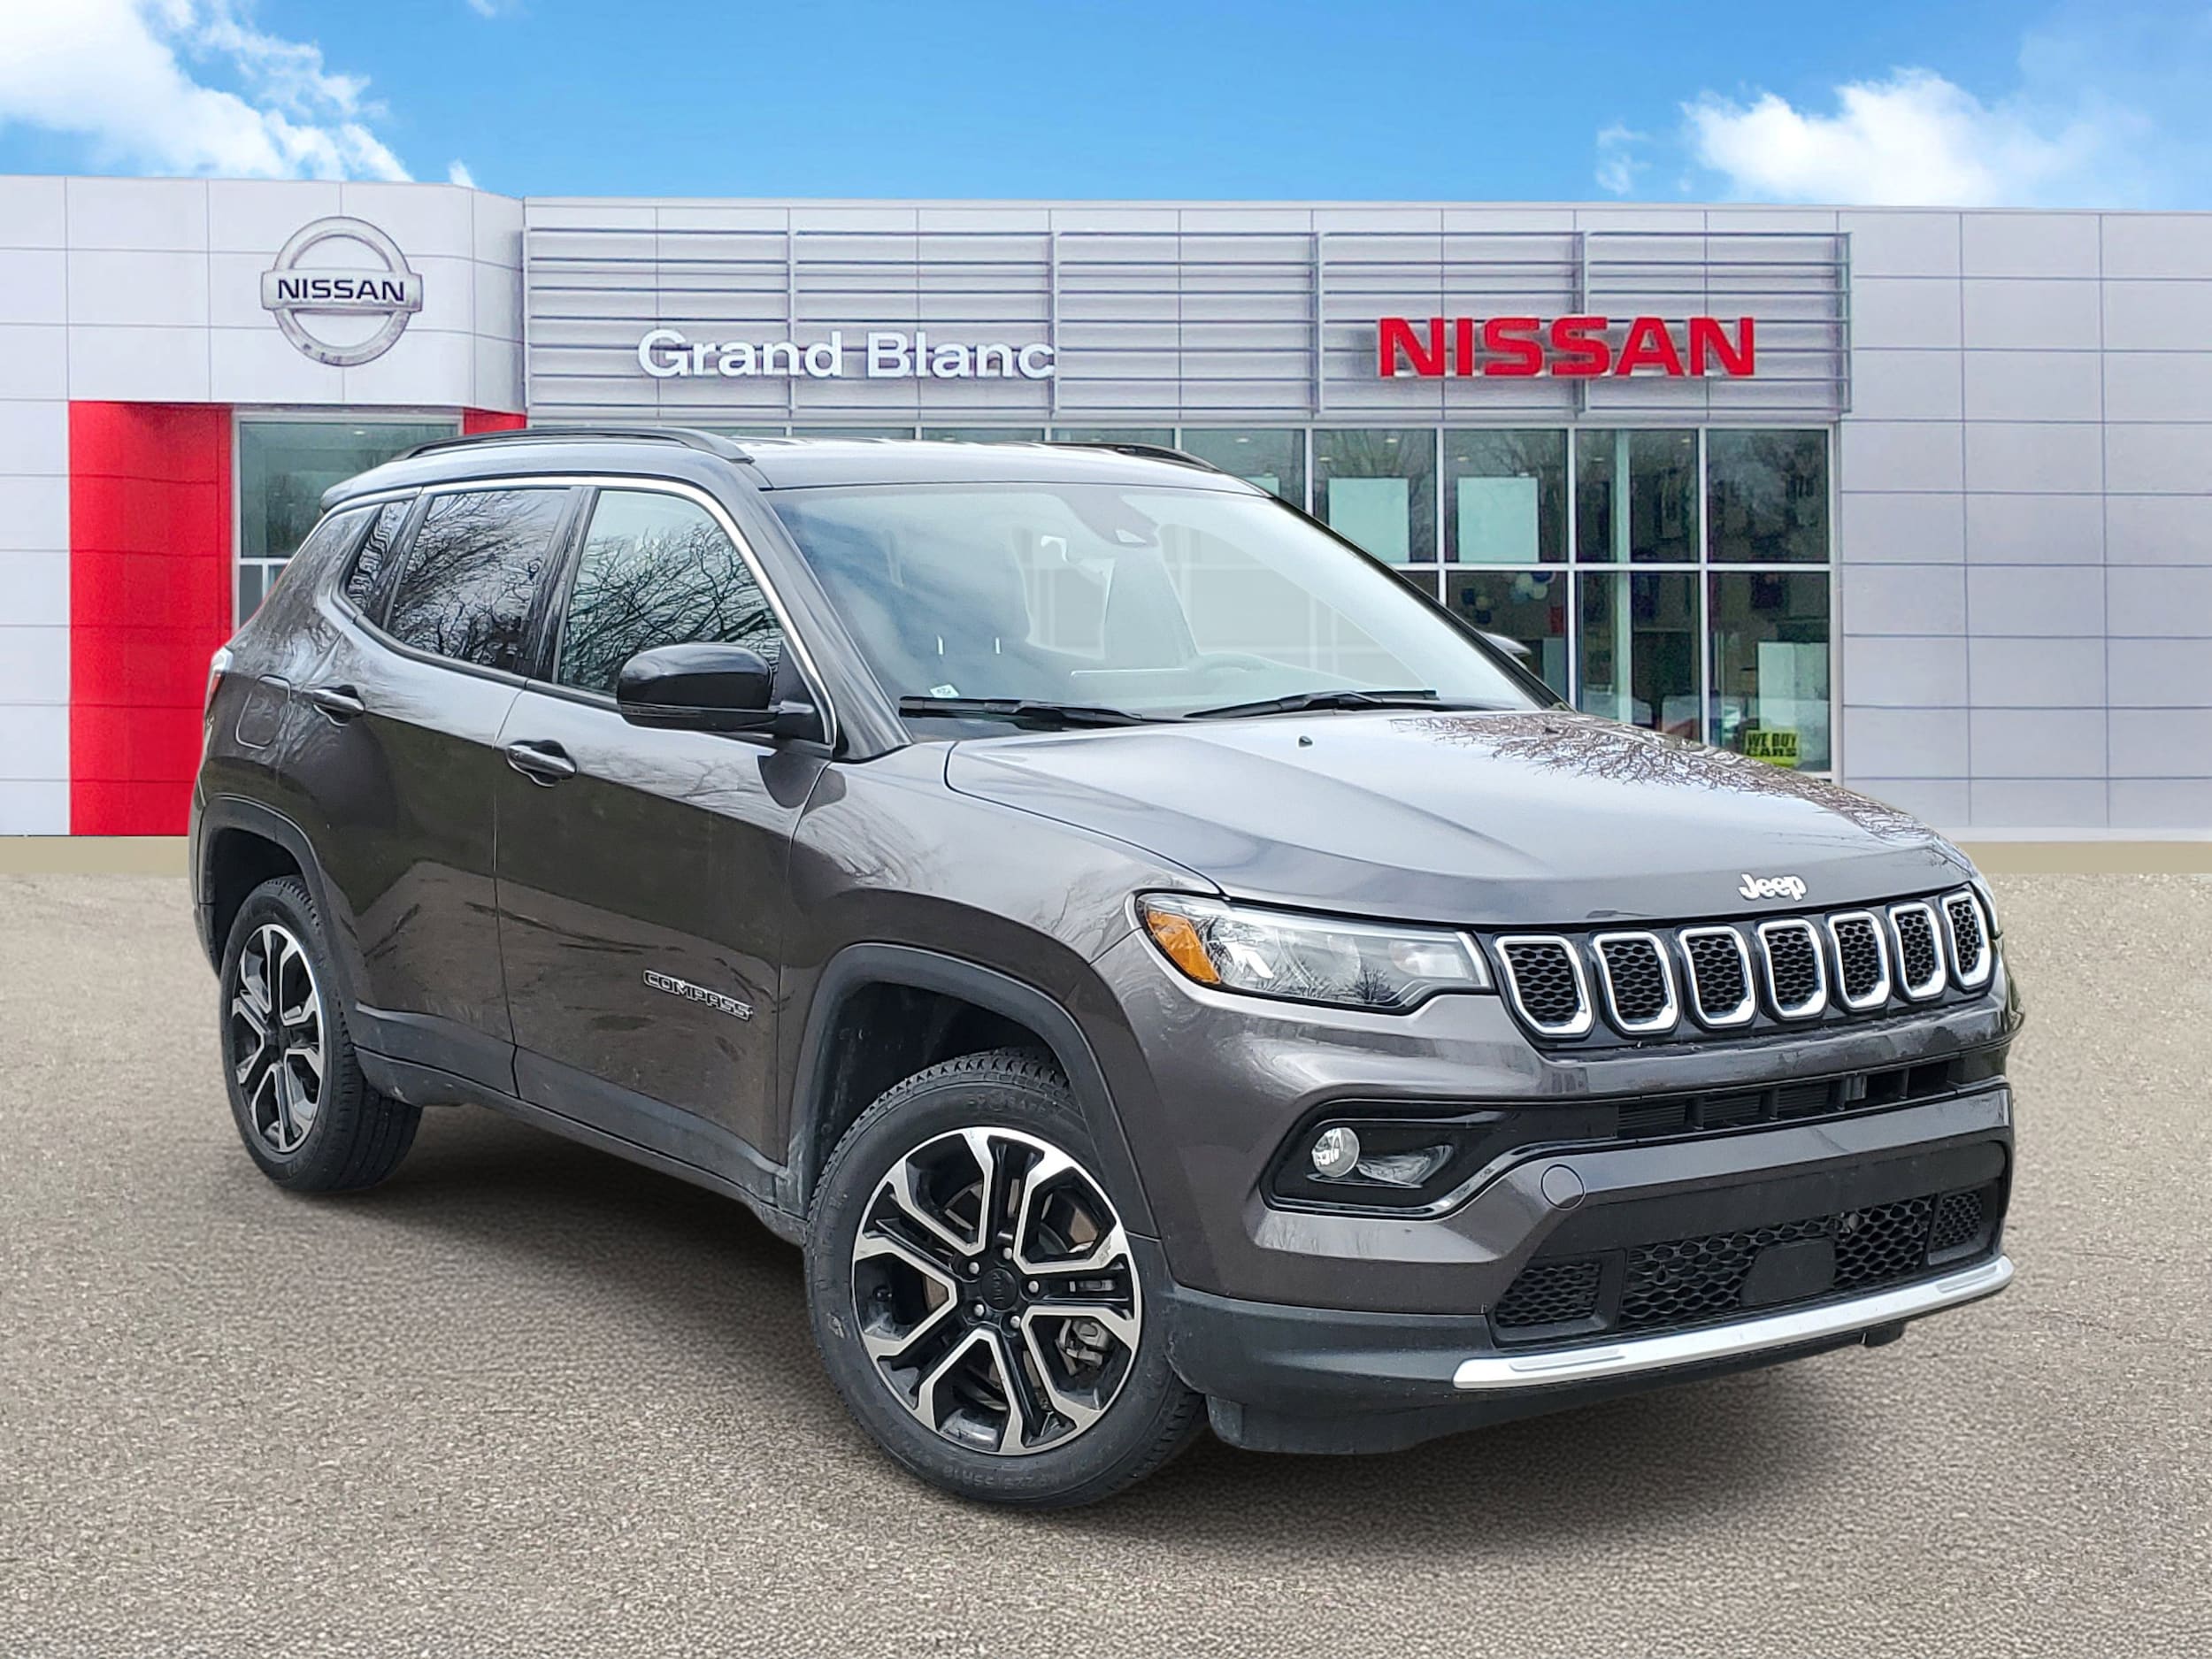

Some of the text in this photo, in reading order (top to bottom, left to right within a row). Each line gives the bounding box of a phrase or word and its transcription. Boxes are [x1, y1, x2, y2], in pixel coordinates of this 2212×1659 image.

[277, 278, 405, 303] NISSAN
[637, 328, 1056, 380] Grand Blanc
[1378, 316, 1756, 379] NISSAN
[1746, 747, 1797, 757] CARS
[1747, 733, 1797, 748] WE BUY
[1738, 872, 1807, 902] Jeep
[643, 970, 753, 1022] COMPASS
